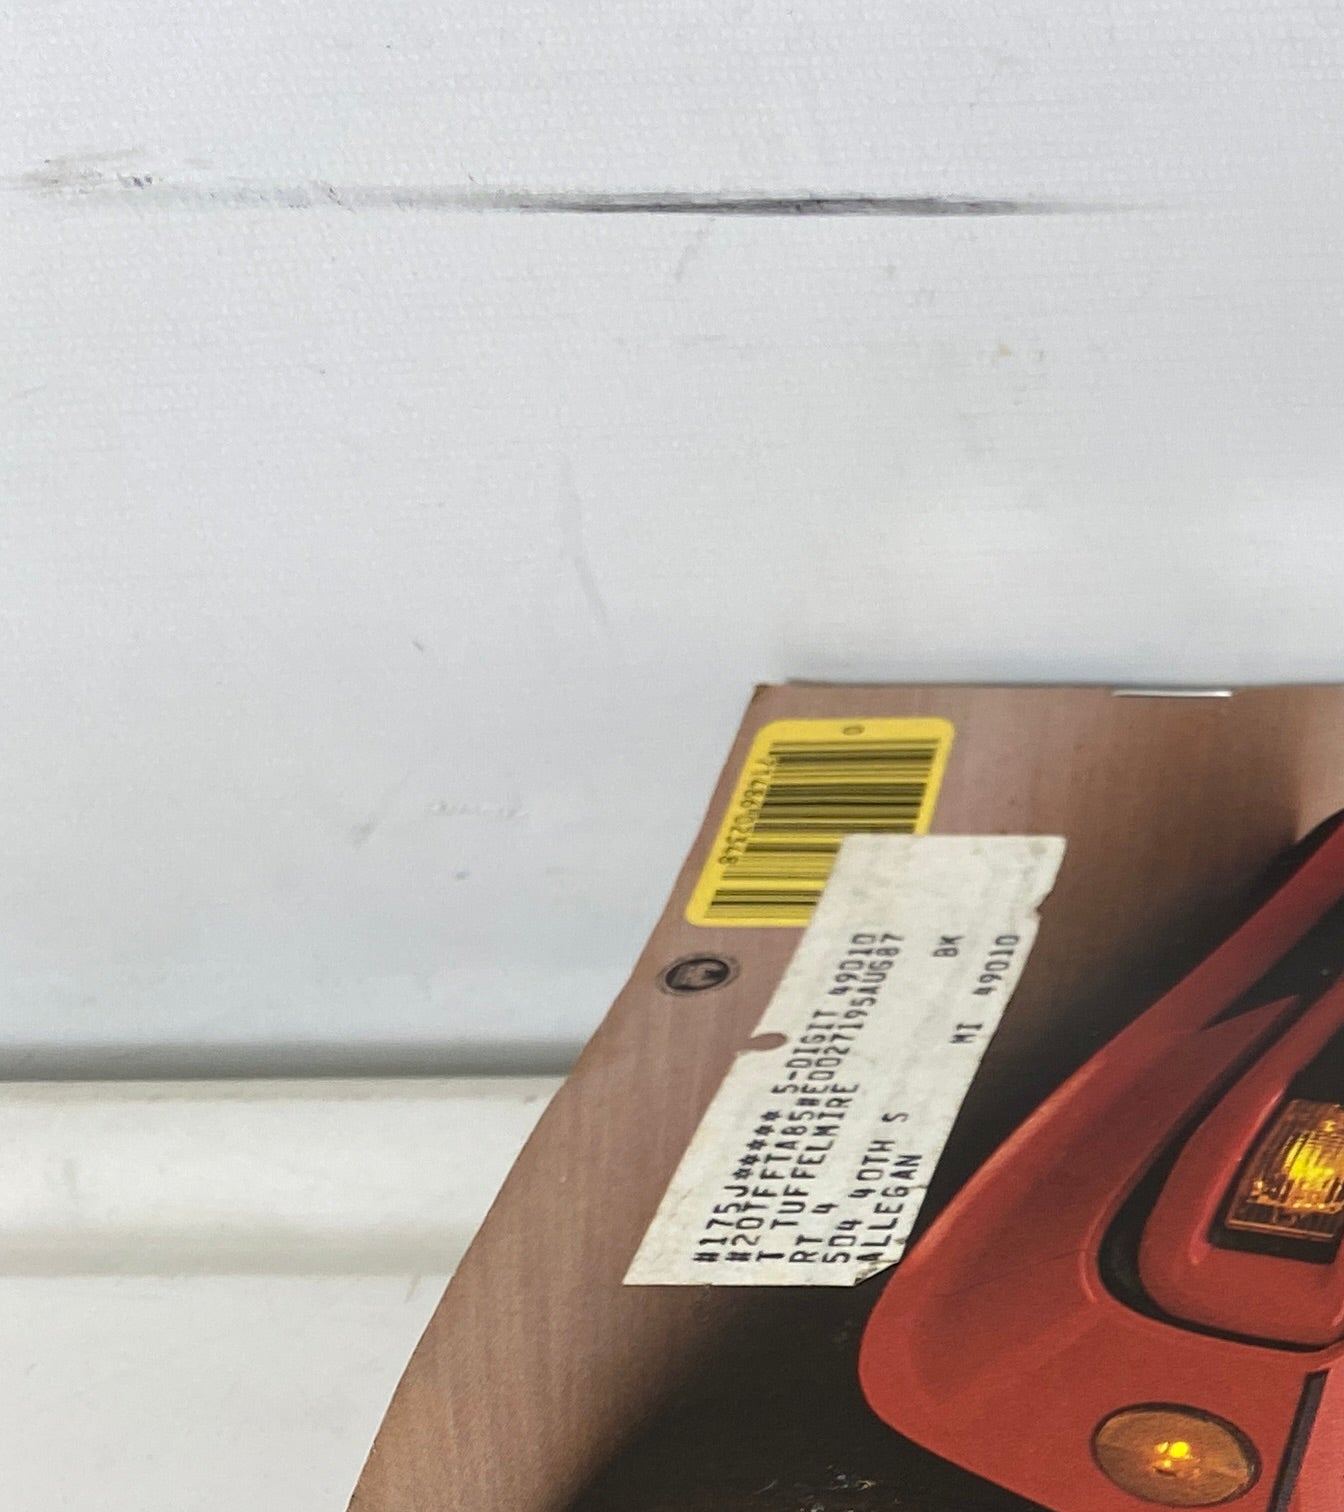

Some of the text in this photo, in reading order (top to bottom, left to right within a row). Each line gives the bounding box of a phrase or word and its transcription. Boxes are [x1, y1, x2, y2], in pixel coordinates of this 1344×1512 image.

[773, 1010, 838, 1095] 5-DIGIT
[828, 933, 880, 997] 49010
[772, 1083, 860, 1230] TUFFELMIRE
[848, 1139, 896, 1201] 40TH
[882, 1112, 909, 1124] S
[855, 934, 1021, 1263] ALLEGAN MI 49010
[788, 1202, 838, 1264] RT 4
